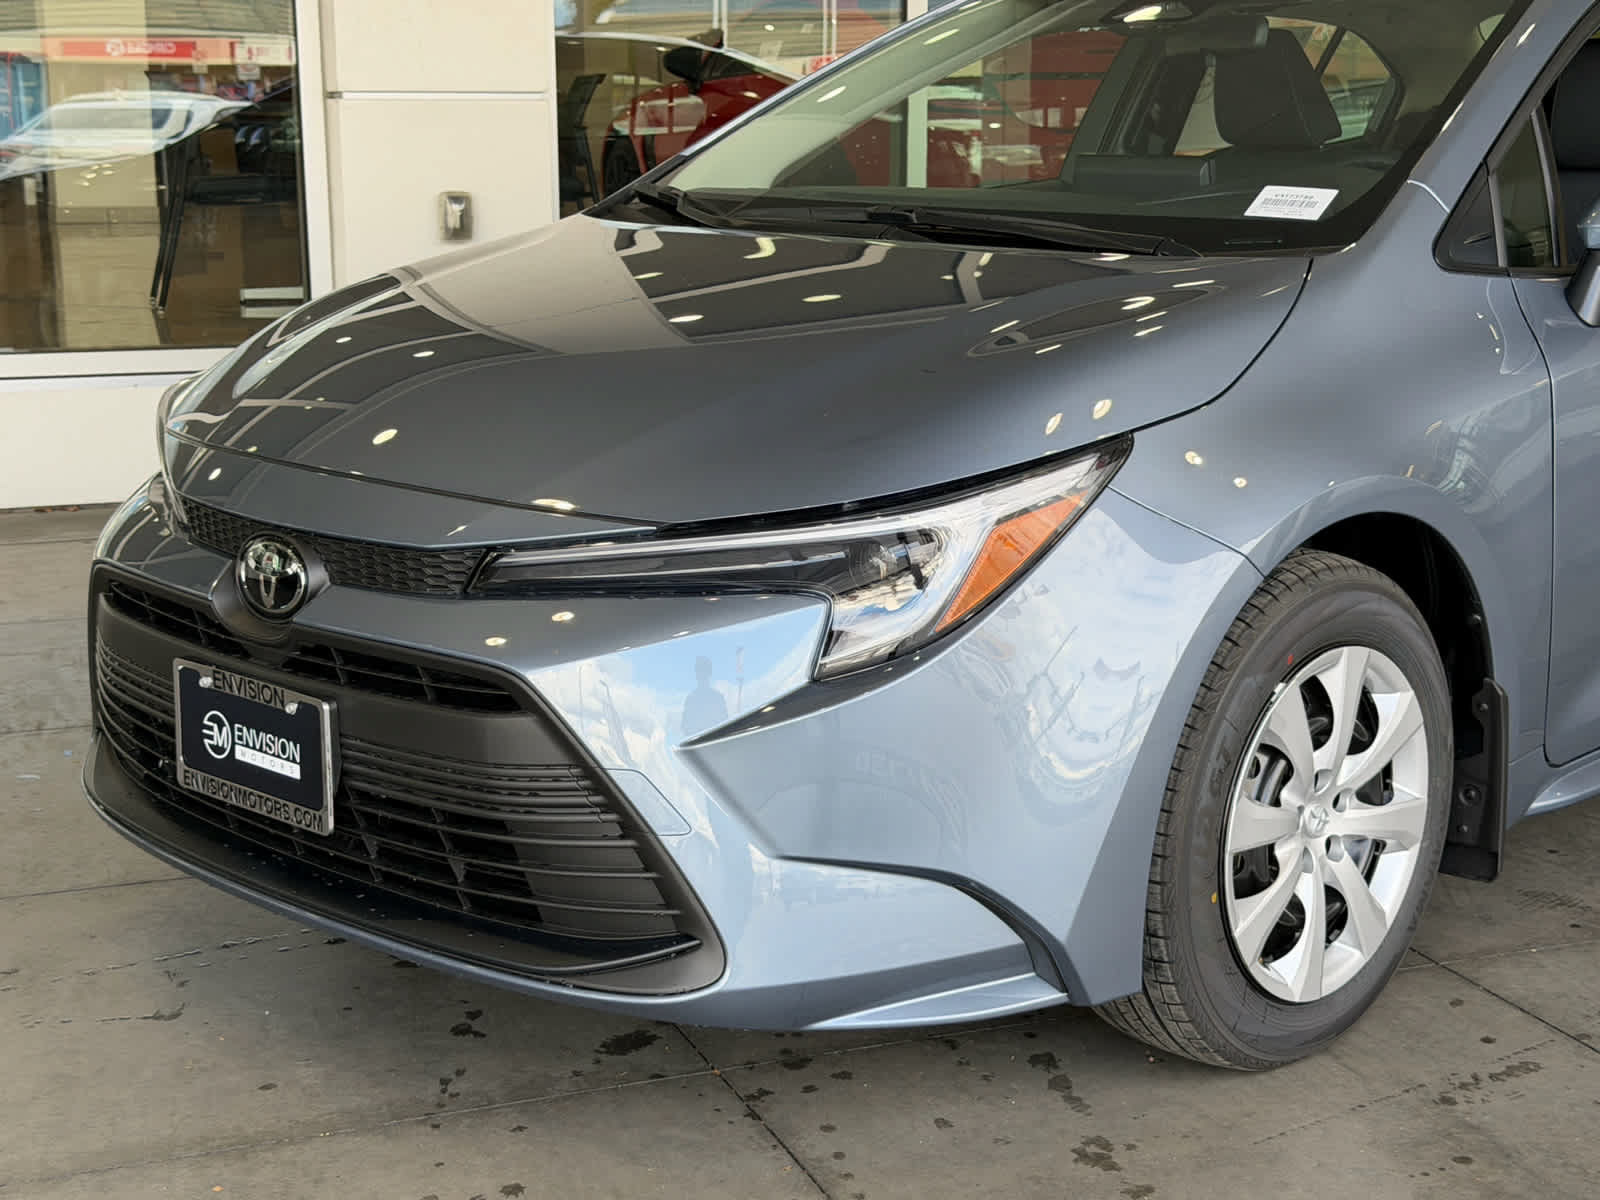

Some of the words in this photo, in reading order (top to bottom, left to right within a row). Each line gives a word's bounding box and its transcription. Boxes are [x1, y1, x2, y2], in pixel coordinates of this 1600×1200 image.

[213, 669, 284, 708] ENVISION
[234, 723, 300, 763] ENVISION
[184, 769, 323, 832] ENVISIONMOTORS.COM
